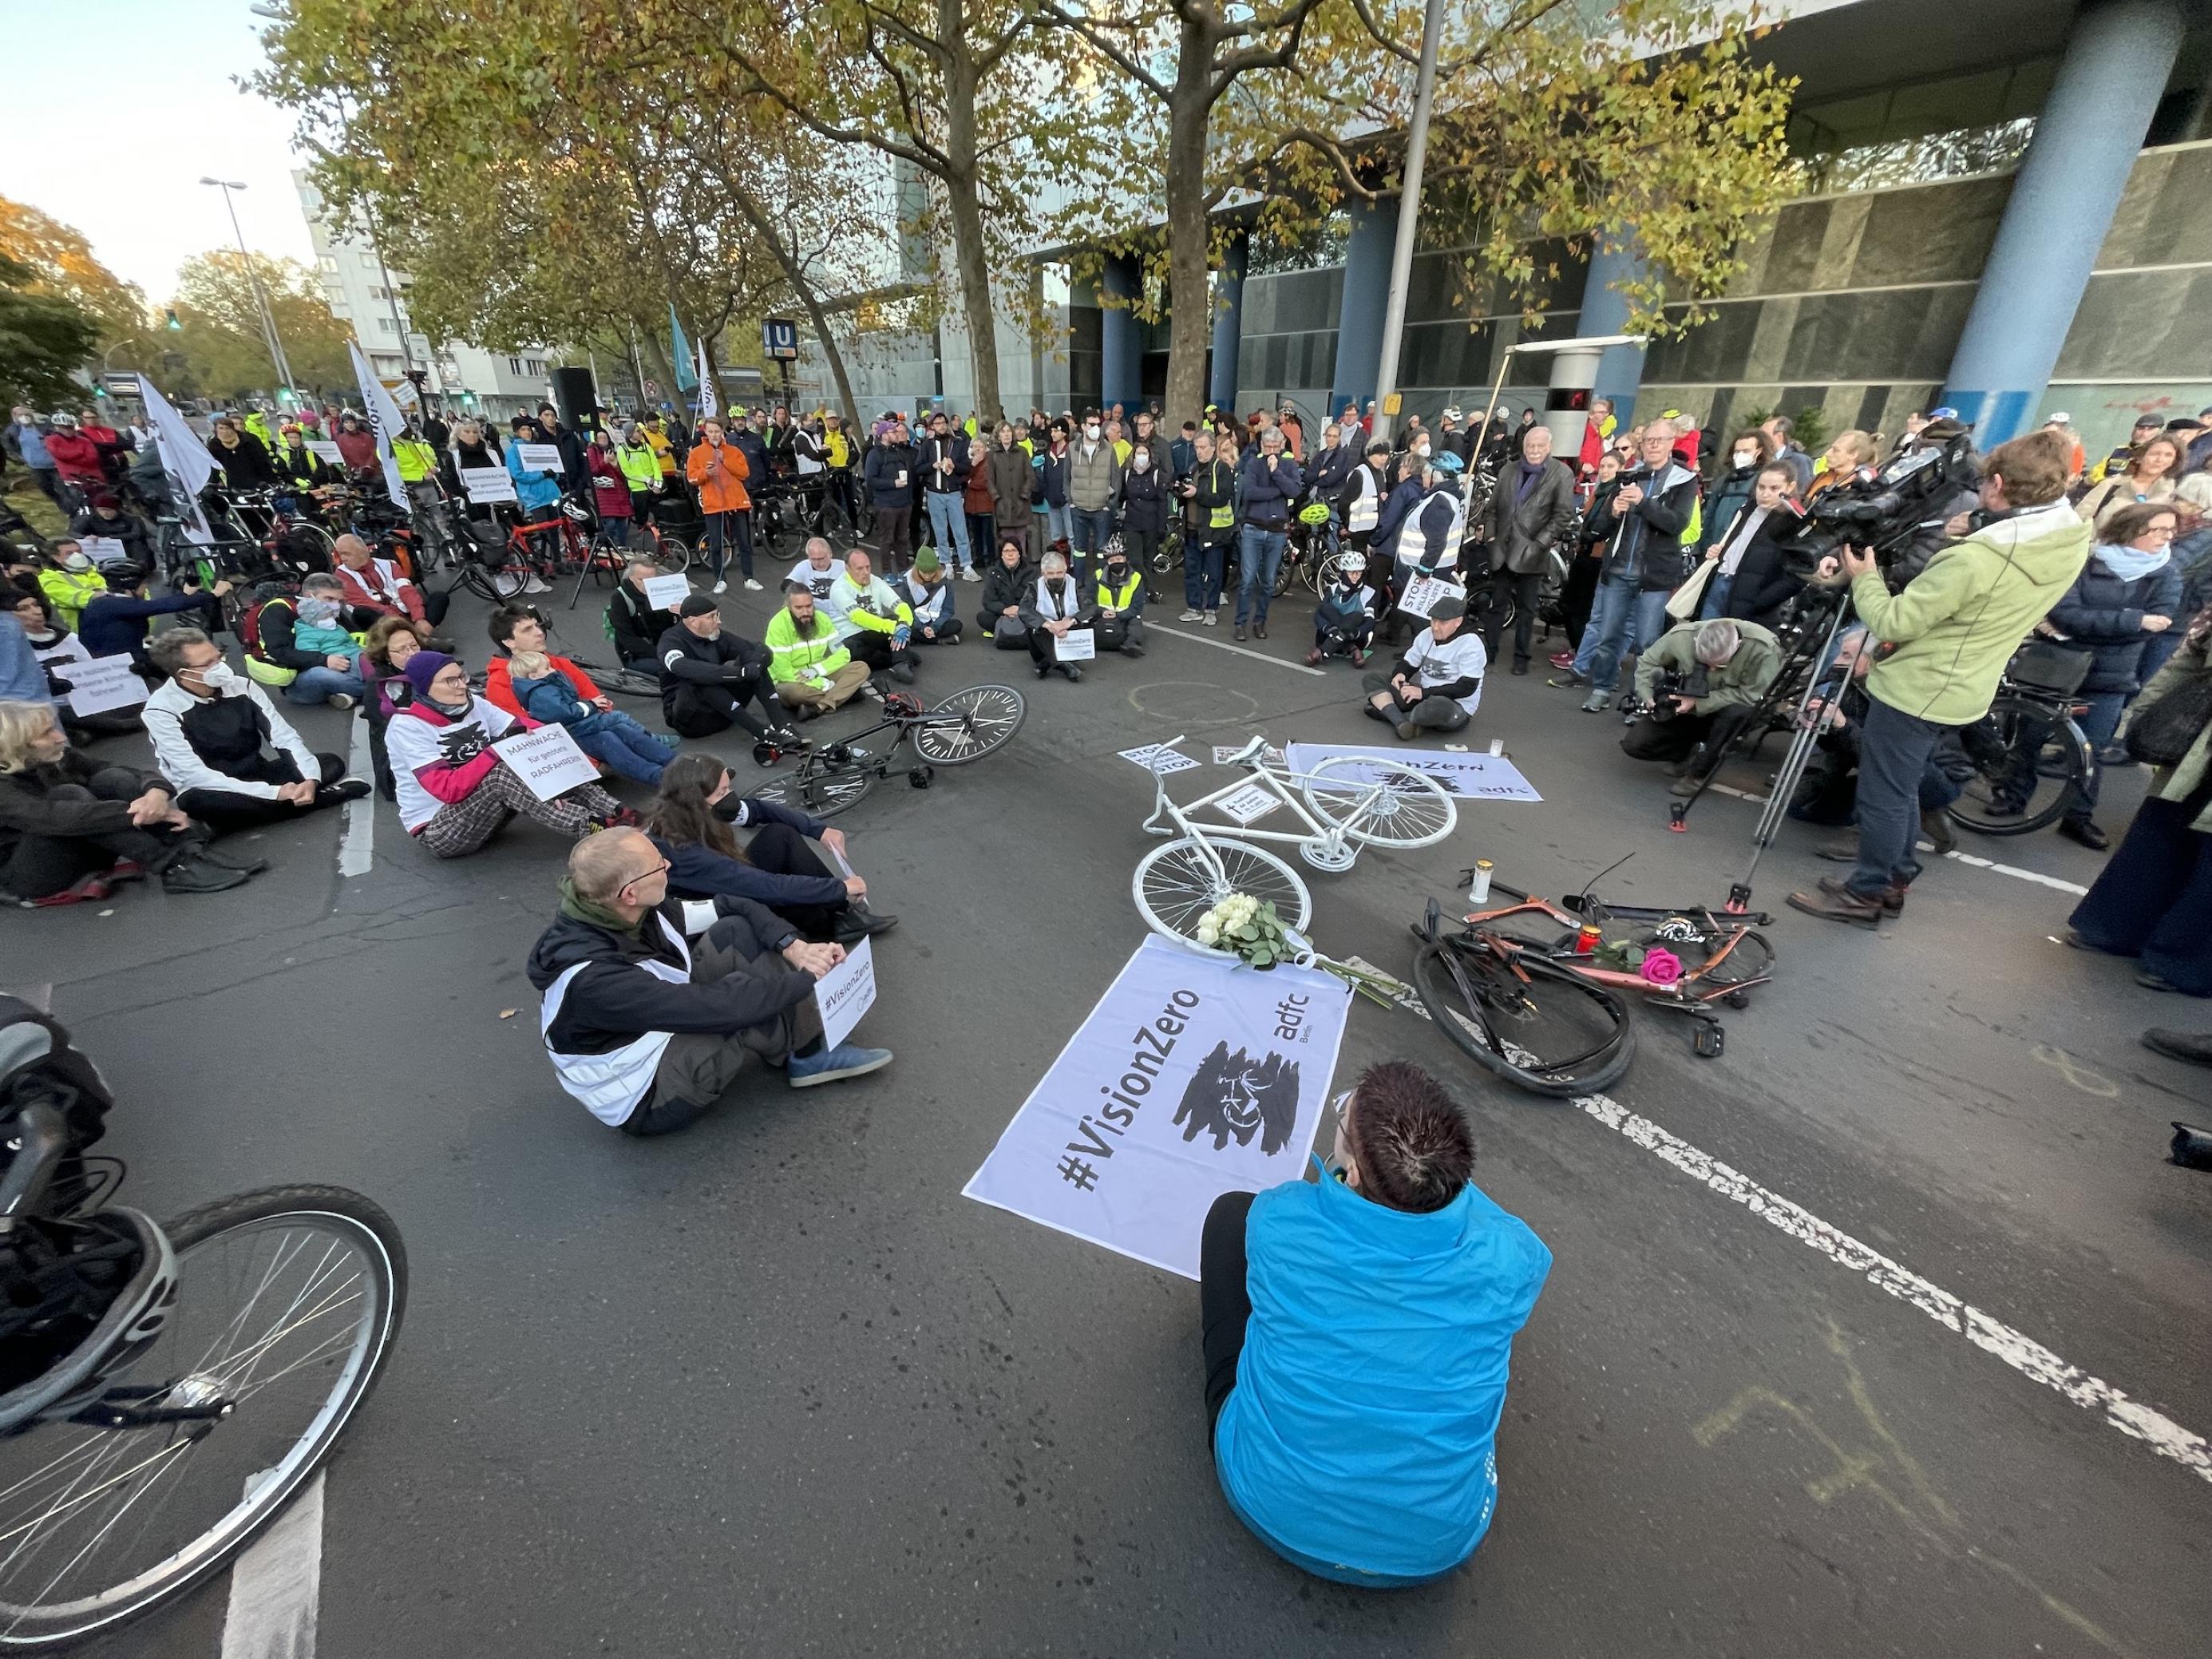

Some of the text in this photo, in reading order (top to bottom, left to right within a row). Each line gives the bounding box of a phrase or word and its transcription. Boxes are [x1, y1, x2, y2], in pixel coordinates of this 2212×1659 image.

[776, 326, 790, 345] U
[1405, 577, 1421, 608] STOP
[506, 731, 564, 755] MAHNWACHE
[528, 754, 540, 764] für
[1155, 759, 1192, 772] STOP
[825, 961, 869, 1011] #VisionZero
[1274, 993, 1310, 1040] adfc
[1057, 989, 1200, 1193] #VisionZero
